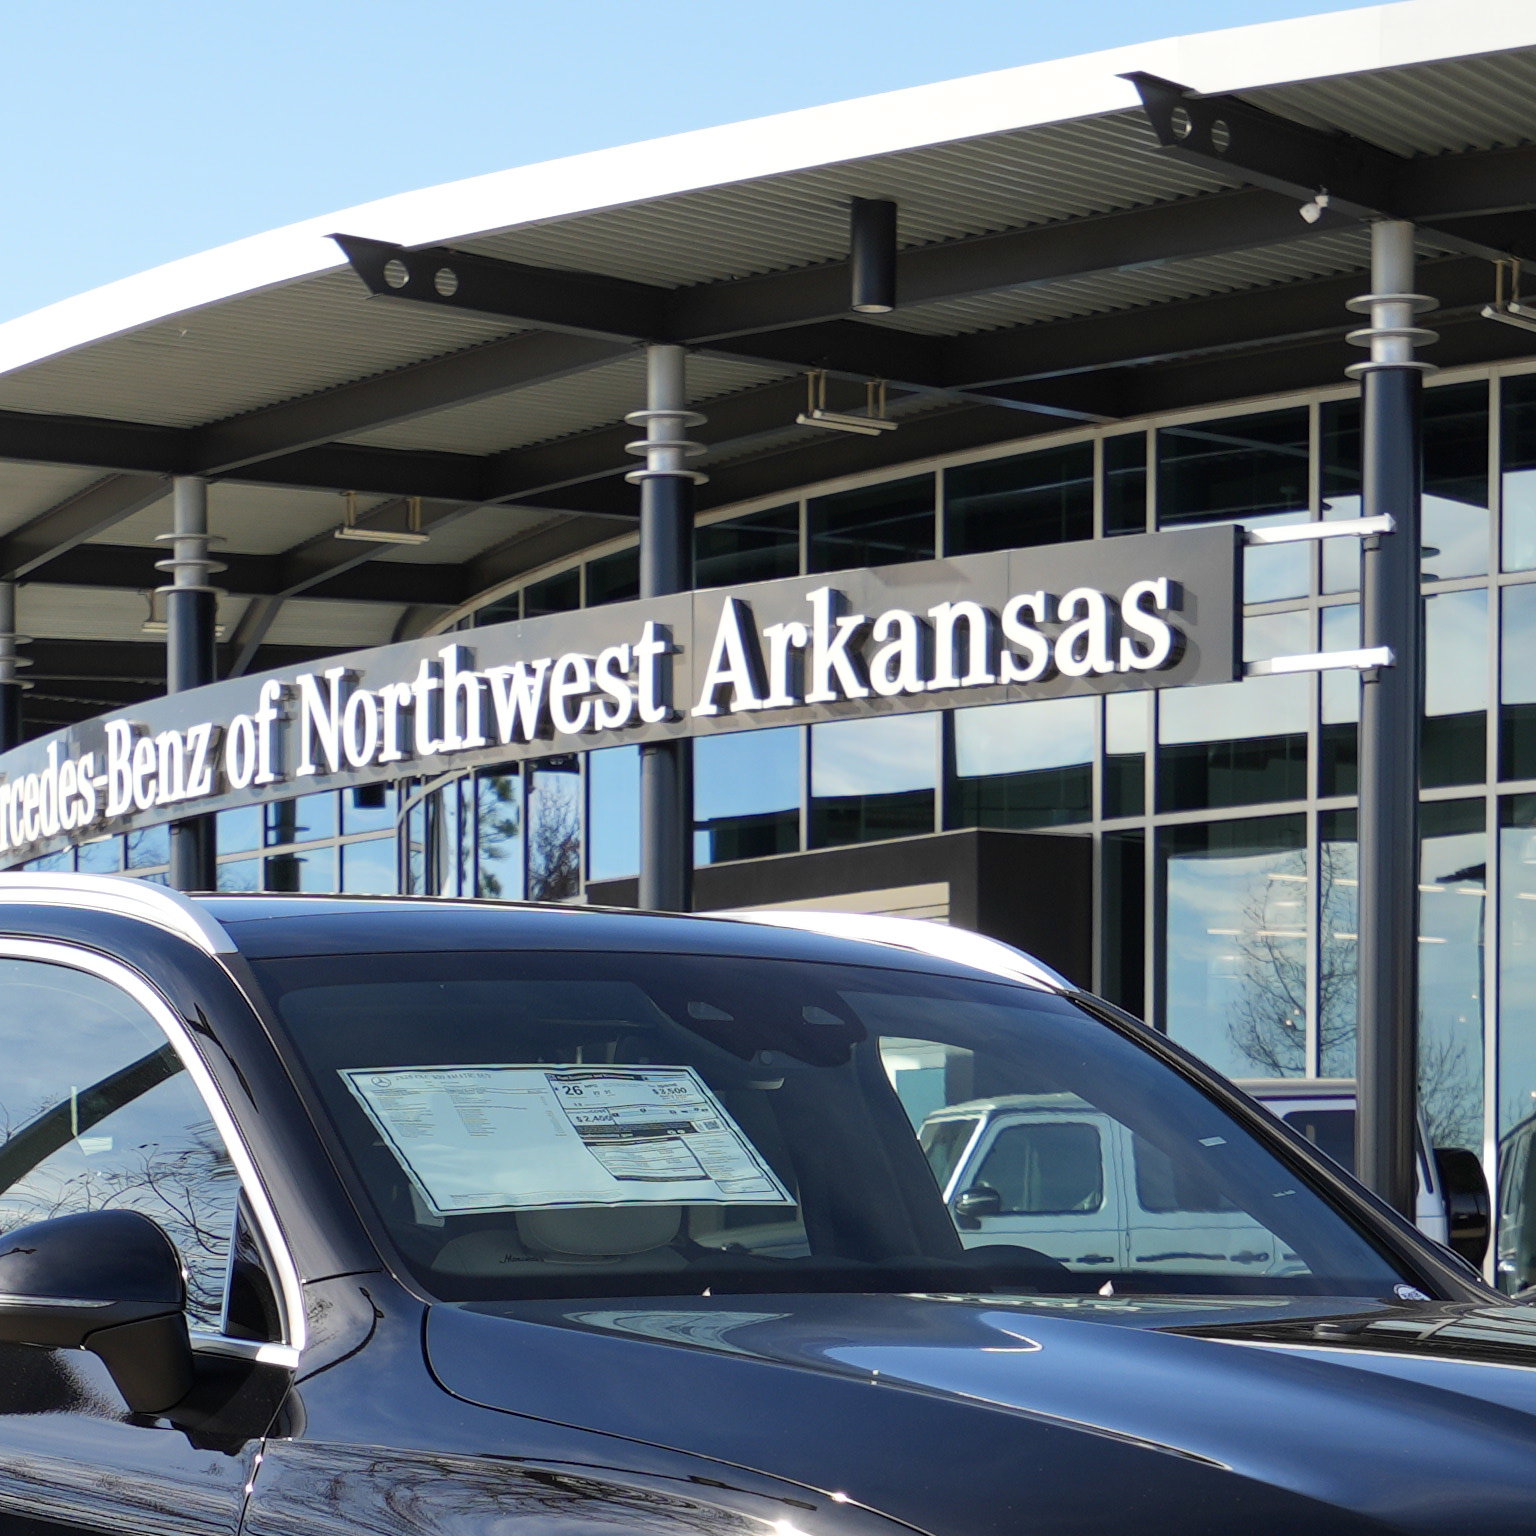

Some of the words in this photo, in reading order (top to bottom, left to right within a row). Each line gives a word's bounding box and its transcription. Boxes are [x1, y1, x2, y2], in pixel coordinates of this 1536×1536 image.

[226, 679, 283, 790] of
[297, 619, 666, 777] Northwest
[691, 576, 1174, 718] Arkansas
[562, 1085, 583, 1096] 26
